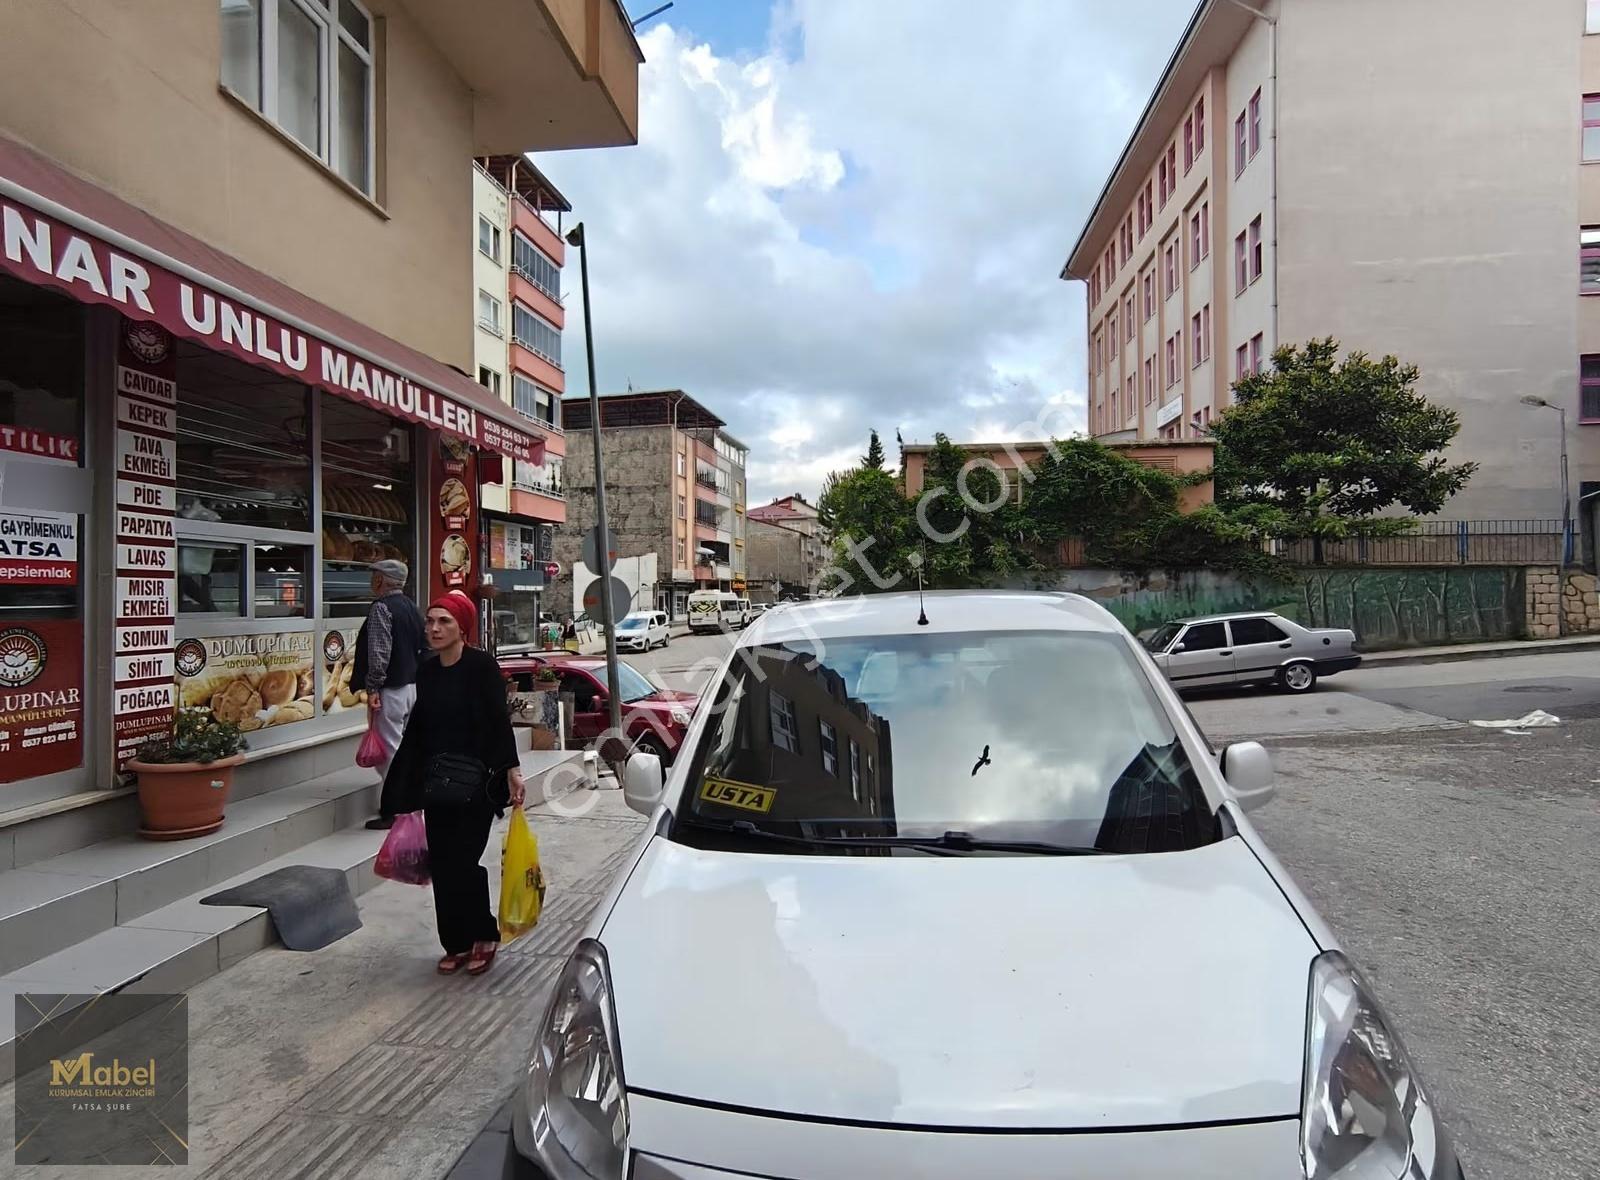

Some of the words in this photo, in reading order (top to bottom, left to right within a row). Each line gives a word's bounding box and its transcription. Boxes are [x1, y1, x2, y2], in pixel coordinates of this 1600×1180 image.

[3, 205, 155, 314] NAR
[180, 283, 307, 371] UNLU
[321, 346, 477, 438] MAMÜLLERİ
[129, 403, 168, 428] KEPEK
[2, 428, 73, 457] TILIK
[133, 435, 162, 456] TAVA
[124, 454, 171, 477] EKMEĞİ
[134, 485, 162, 506] PİDE
[1, 516, 74, 539] GAYRİMENKUL
[121, 516, 173, 537] PAPATYA
[127, 548, 166, 568] LAVAŞ
[0, 565, 72, 580] epsiemlak
[128, 580, 165, 596] MISIR
[122, 597, 169, 616] EKMEĞİ
[122, 630, 168, 648] SOMUN
[128, 657, 163, 678] SİMİT
[120, 689, 170, 711] POĞAÇA
[706, 784, 764, 808] USTA
